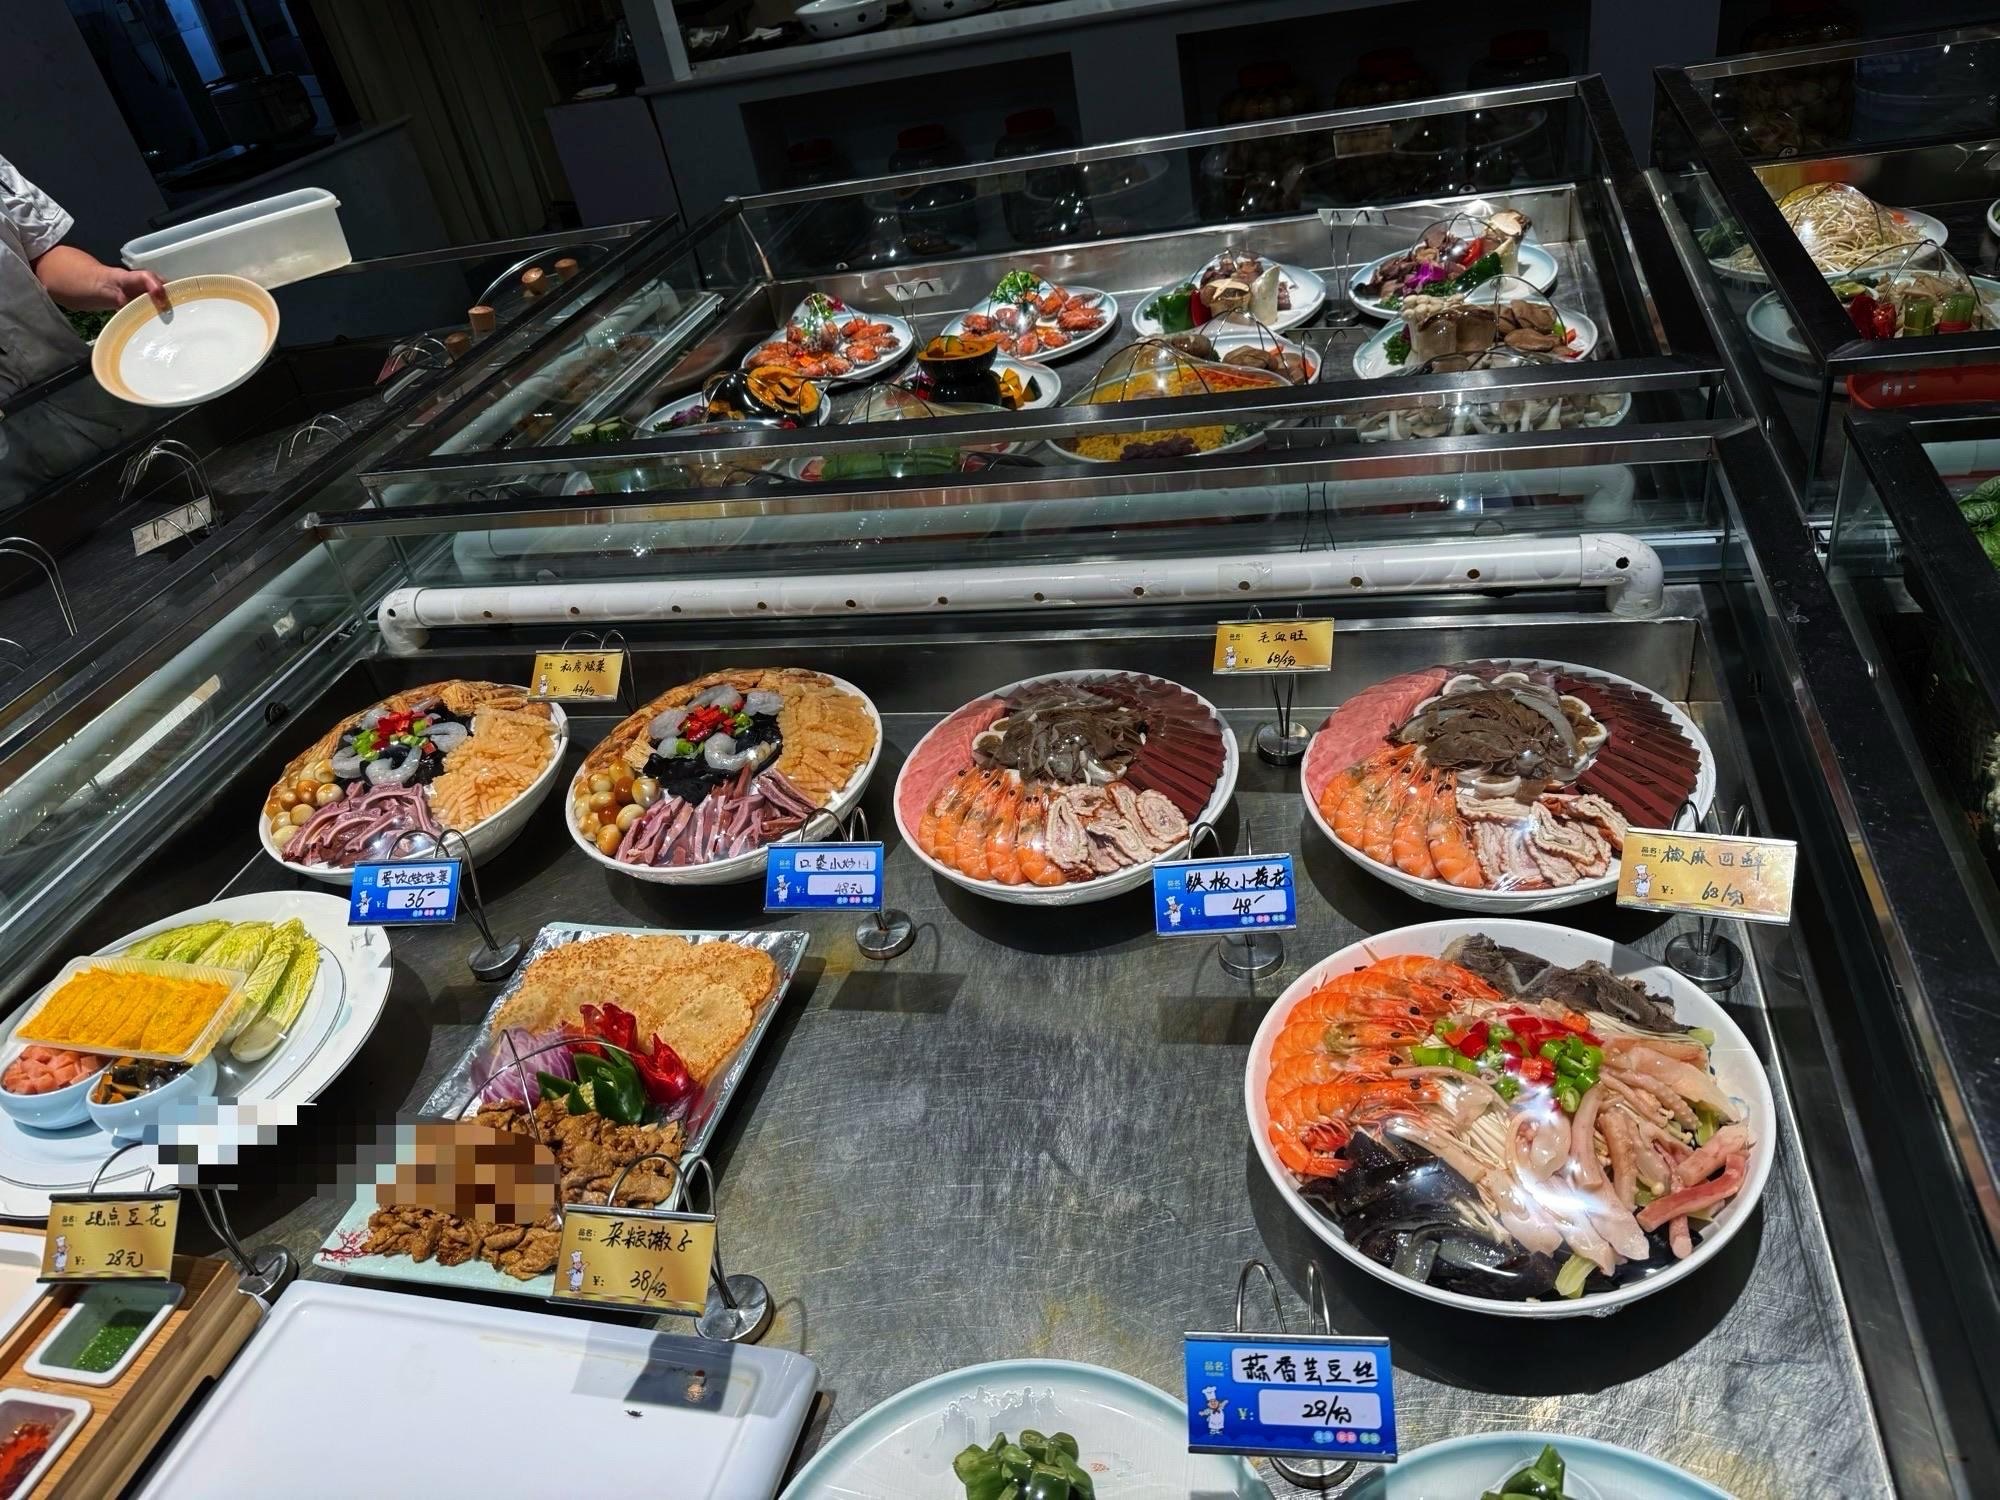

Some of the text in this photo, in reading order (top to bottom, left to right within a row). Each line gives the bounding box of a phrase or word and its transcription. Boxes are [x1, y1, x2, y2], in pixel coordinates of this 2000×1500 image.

[1258, 629, 1308, 643] 毛血旺
[85, 1204, 167, 1228] 现点豆花
[105, 1249, 144, 1268] 28元
[630, 1267, 667, 1303] 38/份
[1241, 1353, 1379, 1386] 蒜香芸豆丝
[1301, 1395, 1352, 1425] 28/份
